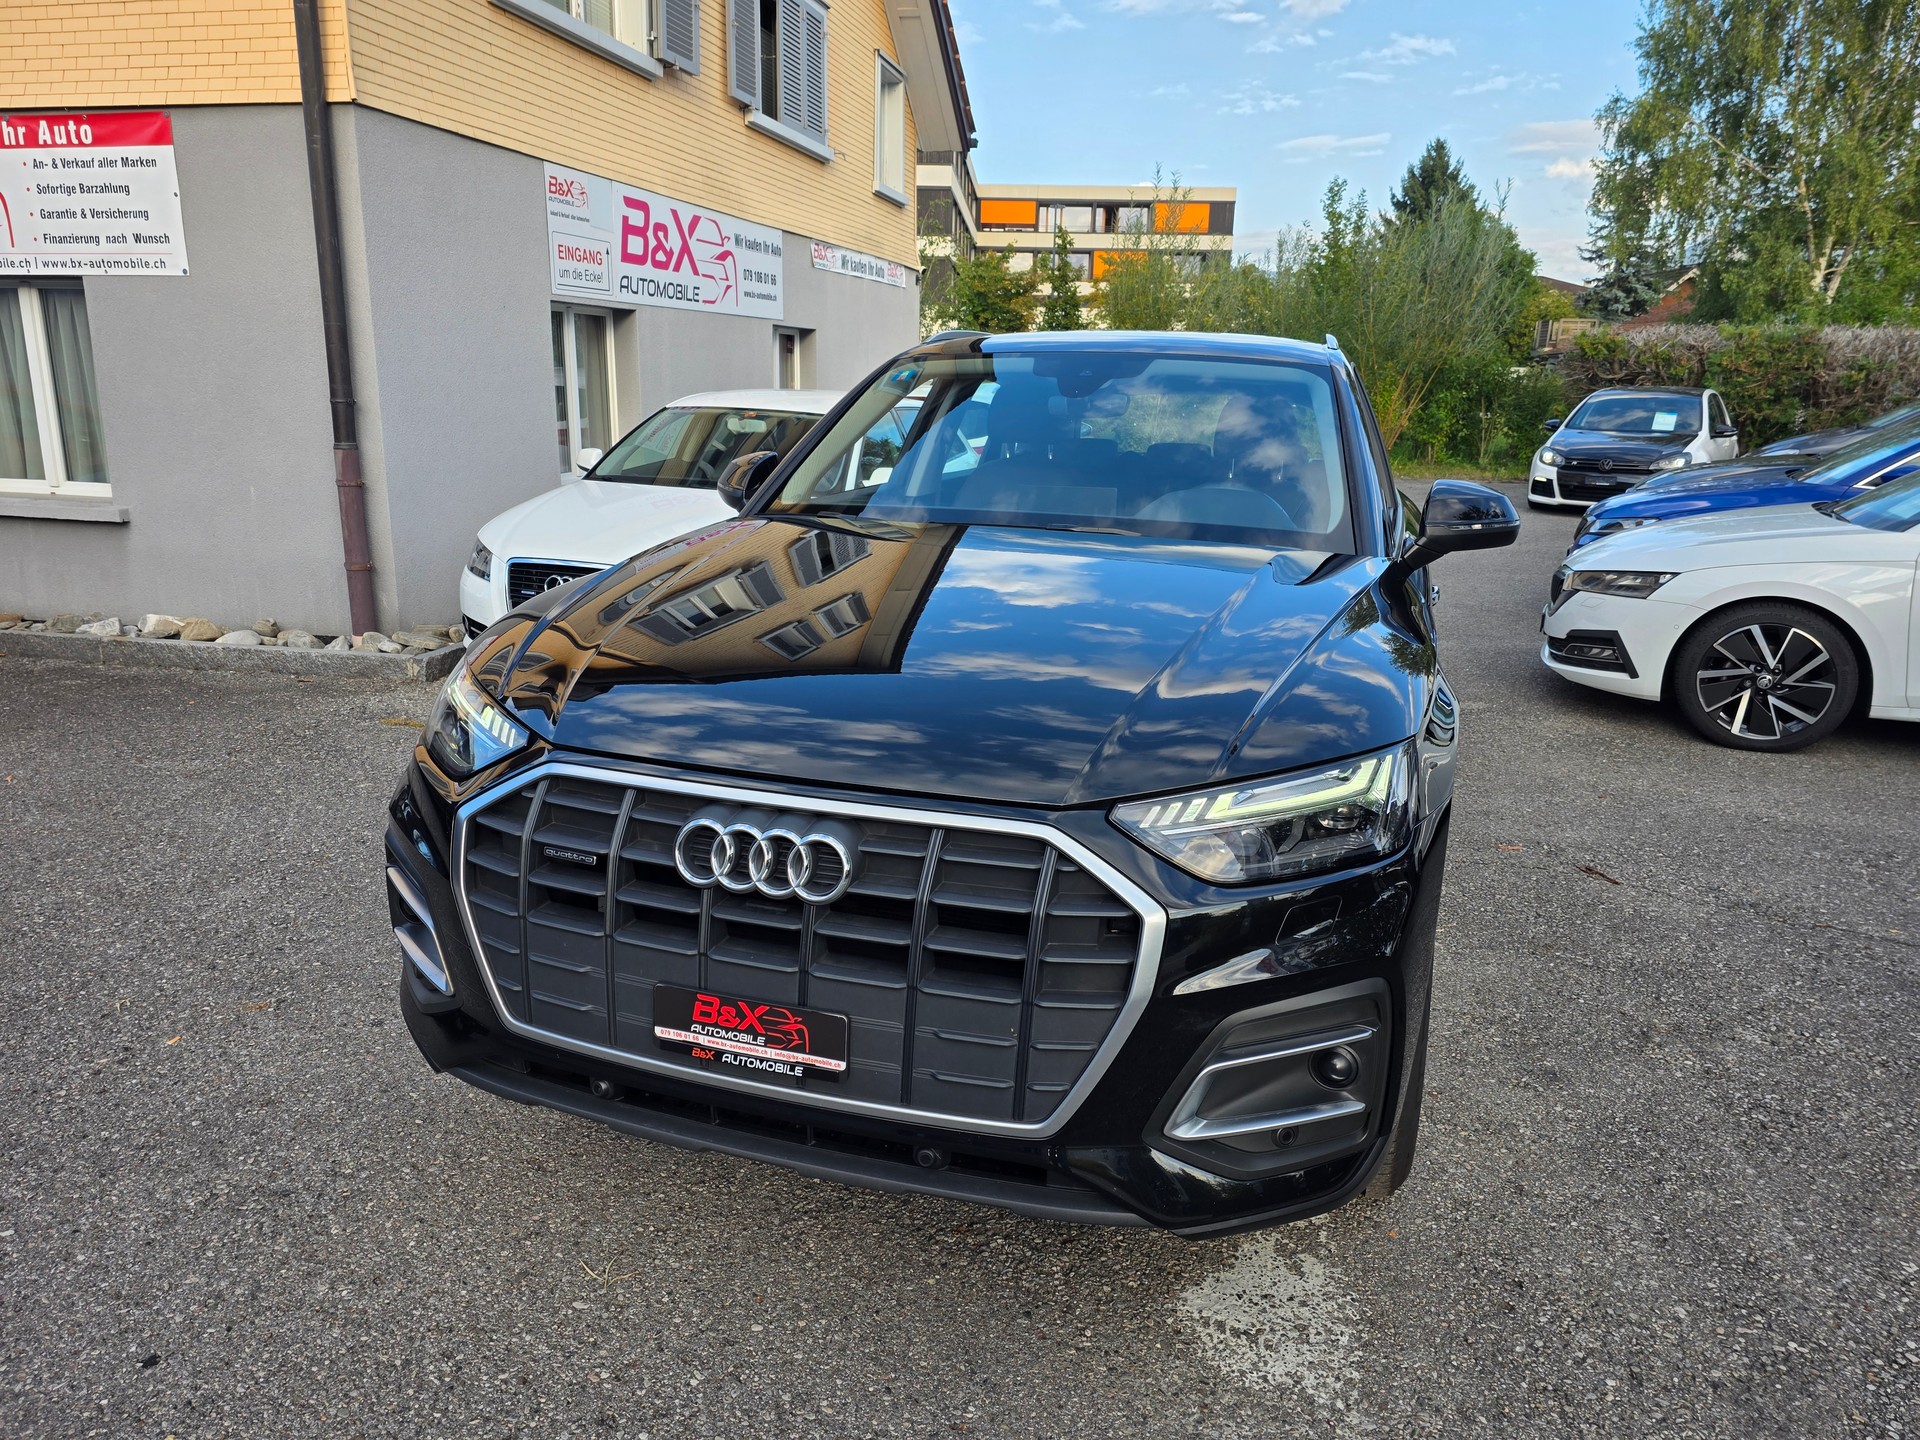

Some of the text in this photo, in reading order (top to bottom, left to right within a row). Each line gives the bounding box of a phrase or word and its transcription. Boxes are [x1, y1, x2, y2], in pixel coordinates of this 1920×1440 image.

[1, 120, 93, 145] hr Auto
[32, 156, 157, 170] An- & Verkauf aller Marken
[36, 183, 130, 196] Sofortige Barzahlung
[549, 175, 574, 199] B&X
[40, 208, 149, 221] Garantie & Versicherung
[43, 233, 170, 247] Finanzierung nach Wunsch
[620, 195, 702, 277] B&X
[734, 233, 743, 247] Wir
[745, 236, 762, 252] kaufen
[771, 242, 781, 256] Auto
[42, 257, 166, 269] www.bx-automobile.ch
[558, 243, 602, 266] EINGANG
[559, 268, 603, 284] um die Ecke!
[743, 269, 777, 286] 079 106 01 66
[841, 254, 849, 270] Wir
[850, 256, 867, 274] kaufen
[875, 263, 885, 279] Auto
[619, 275, 700, 303] AUTOMOBILE
[546, 849, 593, 863] quattro
[692, 993, 770, 1034] B&X
[660, 1028, 671, 1036] 079
[707, 1039, 768, 1056] www.bx-automobile.ch
[690, 1024, 766, 1046] AUTOMOBILE
[692, 1047, 804, 1077] B&X AUTOMOBILE
